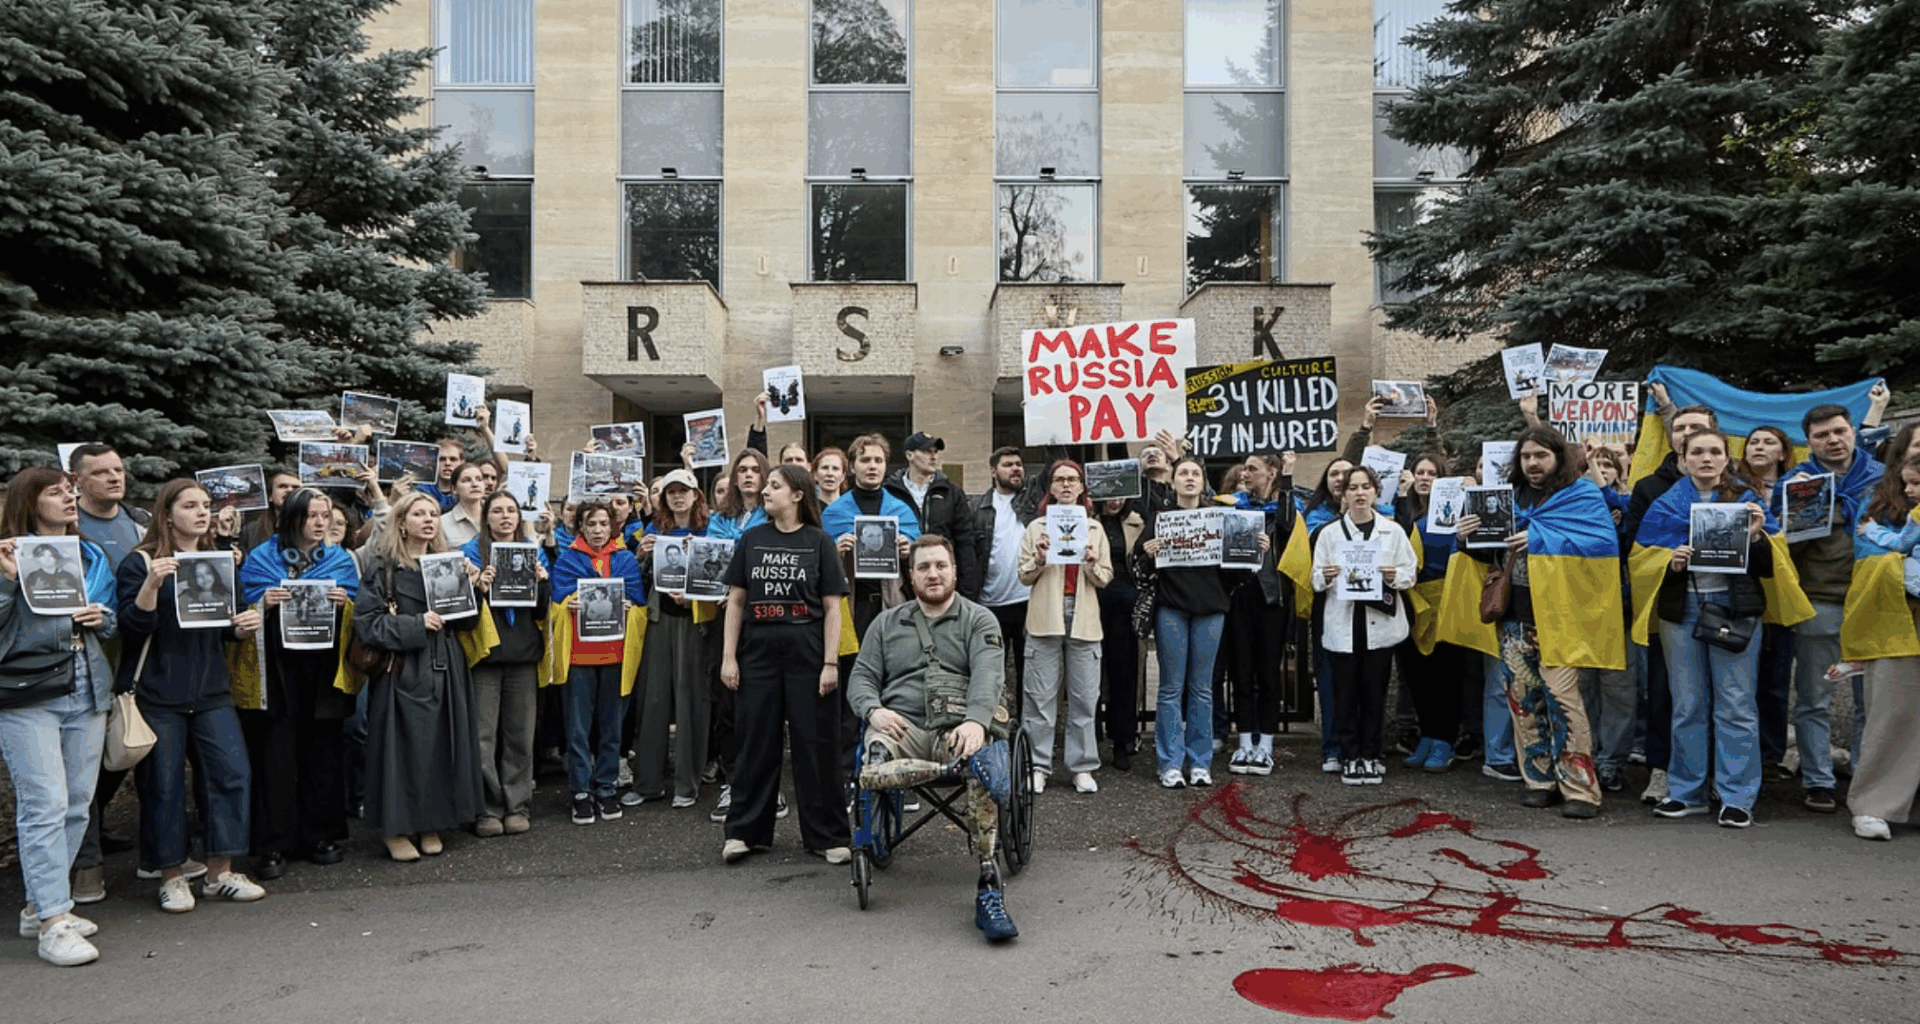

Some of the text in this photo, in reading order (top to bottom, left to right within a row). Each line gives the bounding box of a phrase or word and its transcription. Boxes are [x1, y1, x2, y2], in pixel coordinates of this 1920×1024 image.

[627, 305, 1286, 363] R S K
[1028, 321, 1178, 363] MAKE
[1028, 356, 1178, 396] RUSSIA
[1186, 360, 1335, 391] RUSSIAN CULTURE
[1205, 375, 1339, 418] 34 KILLED
[1552, 382, 1635, 401] MORE
[1068, 392, 1155, 443] PAY
[1551, 400, 1638, 422] WEAPONS
[1187, 418, 1339, 456] 117 INJURED
[751, 566, 807, 582] RUSSIA
[761, 552, 800, 566] MAKE
[764, 581, 793, 596] PAY
[753, 604, 785, 619] $300
